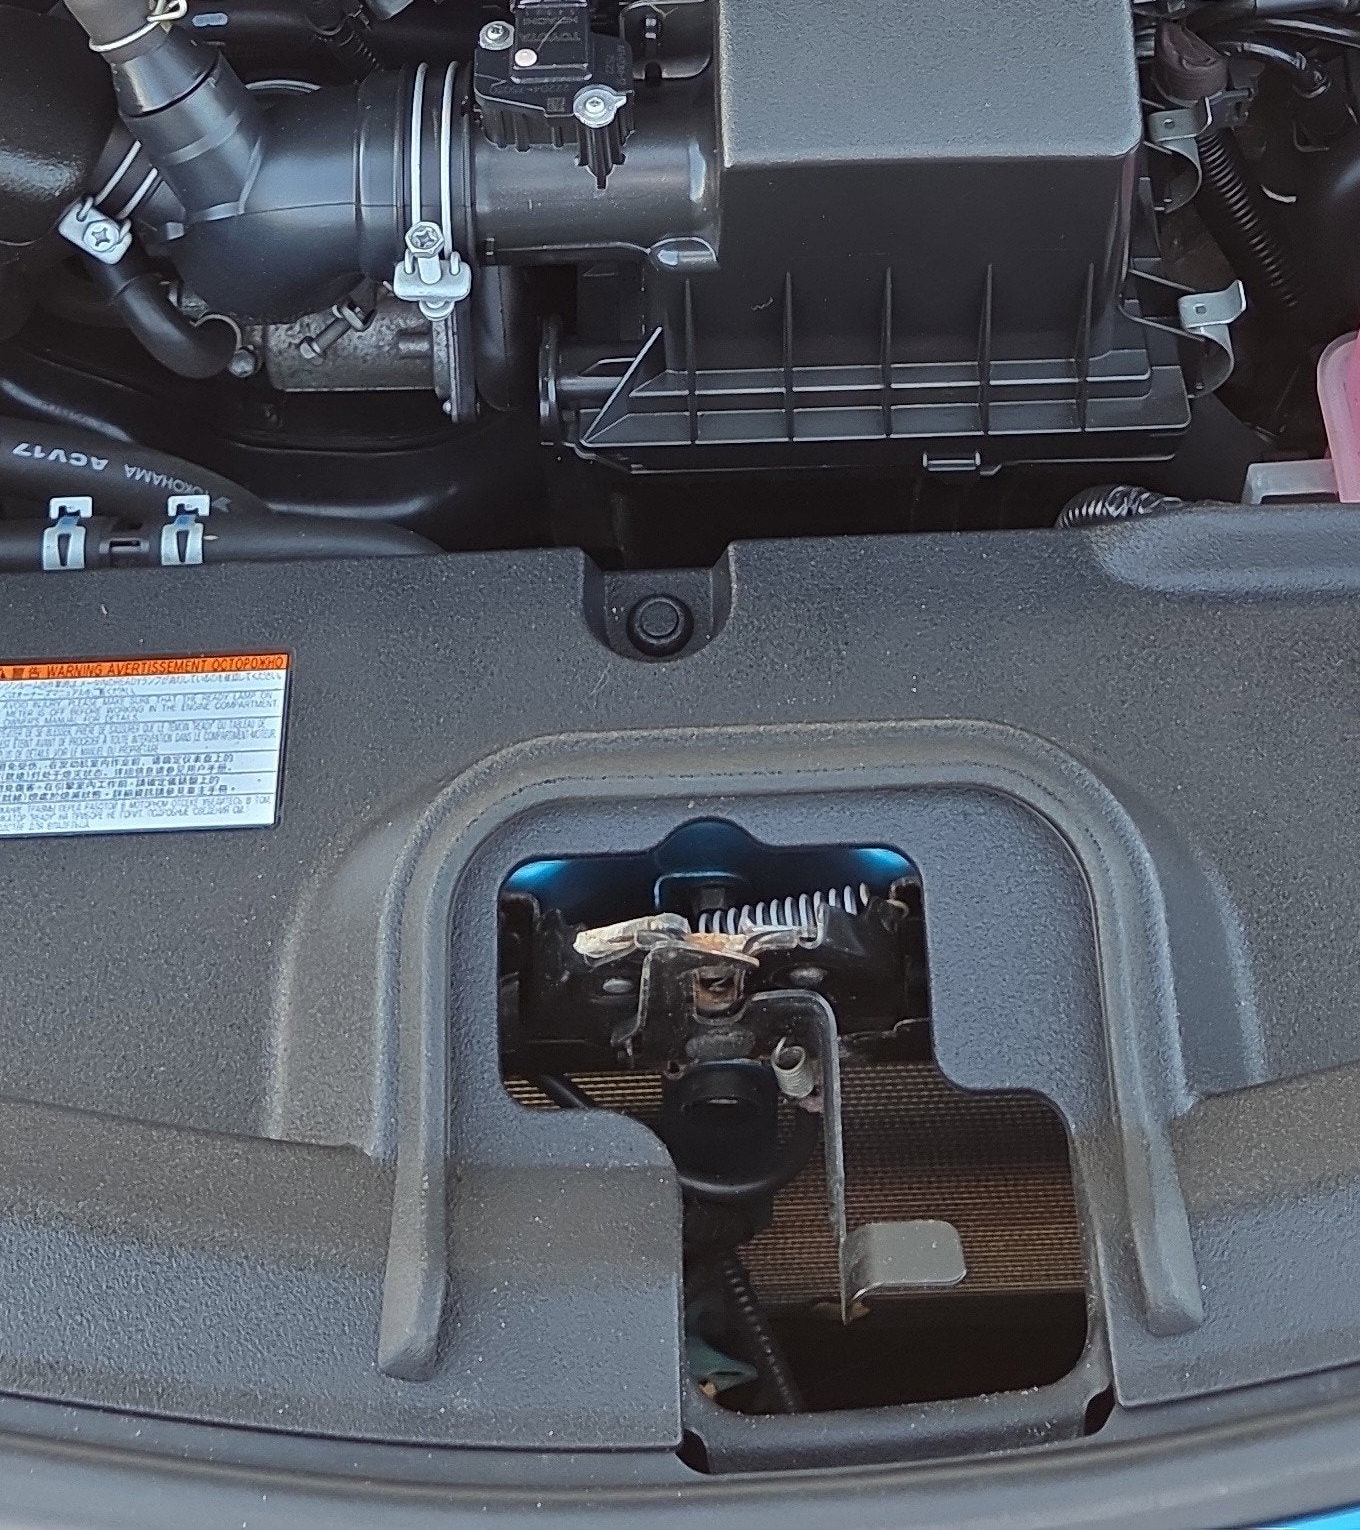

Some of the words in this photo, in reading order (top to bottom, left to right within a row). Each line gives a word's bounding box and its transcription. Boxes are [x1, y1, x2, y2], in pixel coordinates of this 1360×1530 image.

[12, 441, 110, 471] ACV17
[124, 464, 209, 495] OKOHAMA
[46, 663, 104, 678] WARNING
[106, 659, 208, 675] AVERTISSEMENT
